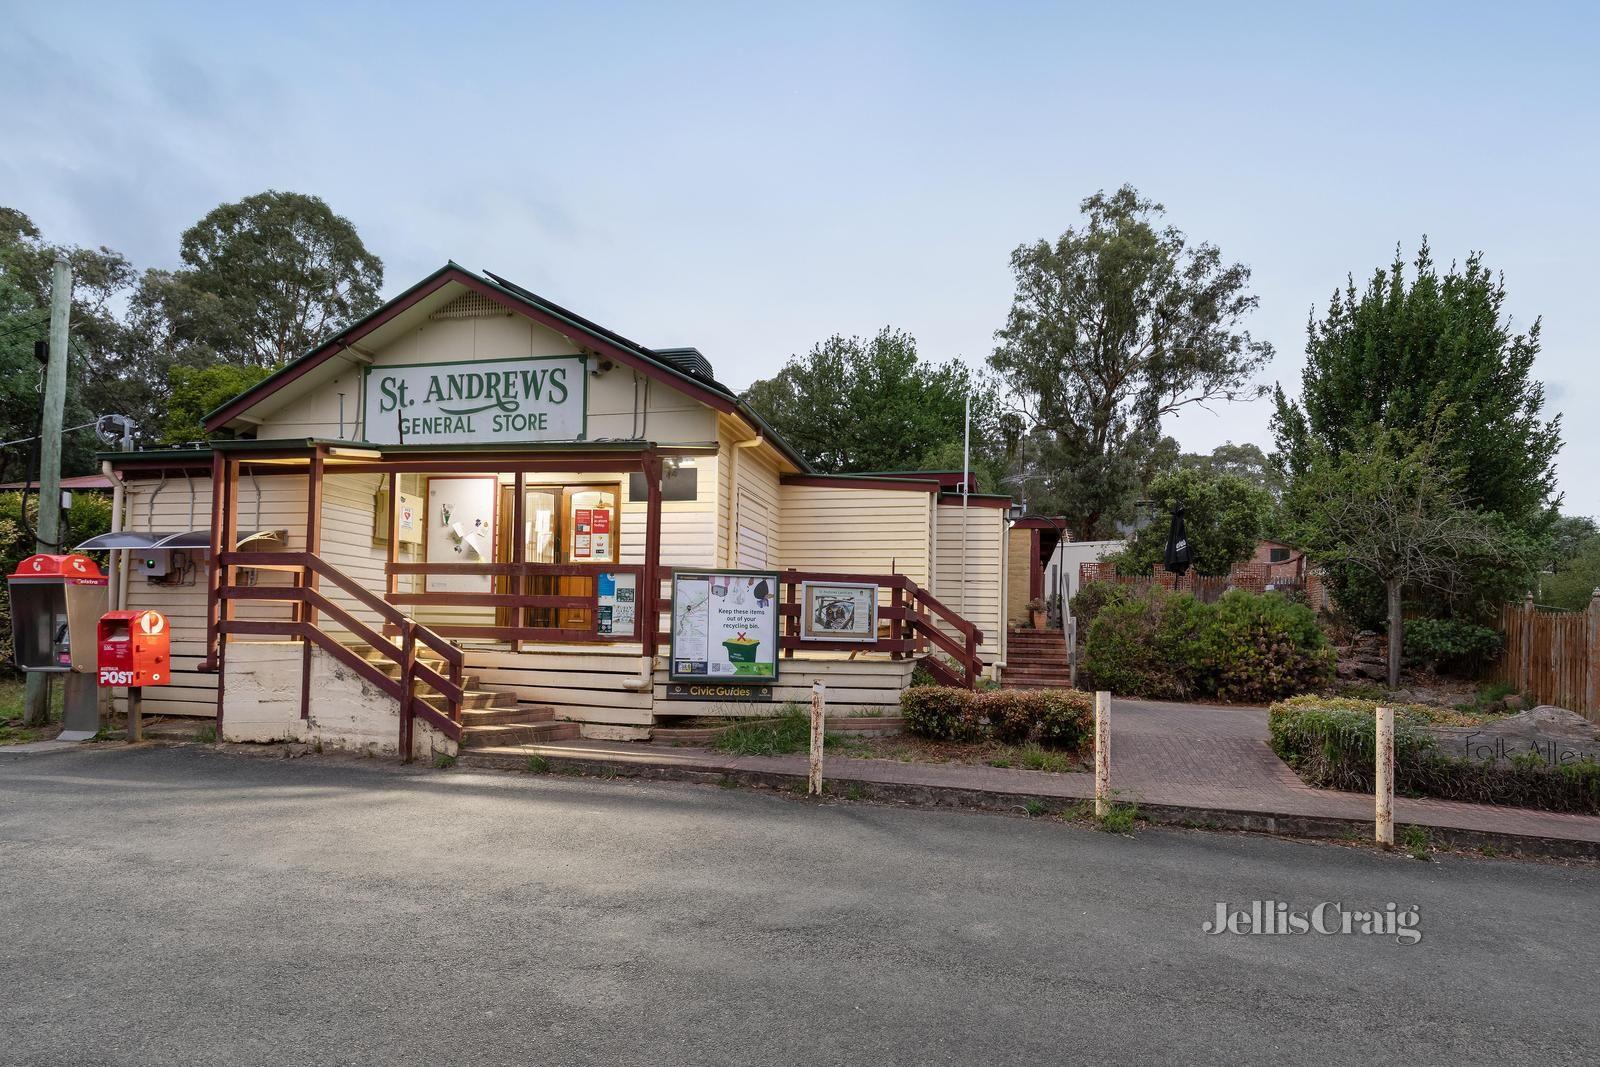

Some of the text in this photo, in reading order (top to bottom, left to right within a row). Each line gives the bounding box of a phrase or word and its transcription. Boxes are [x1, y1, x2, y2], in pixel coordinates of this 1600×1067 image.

[380, 368, 568, 415] St. ANDREWS
[398, 413, 548, 435] GENERAL STORE
[723, 622, 749, 630] recycling
[100, 671, 134, 684] POST
[690, 686, 751, 696] Civic Guides
[1465, 731, 1515, 760] Folk
